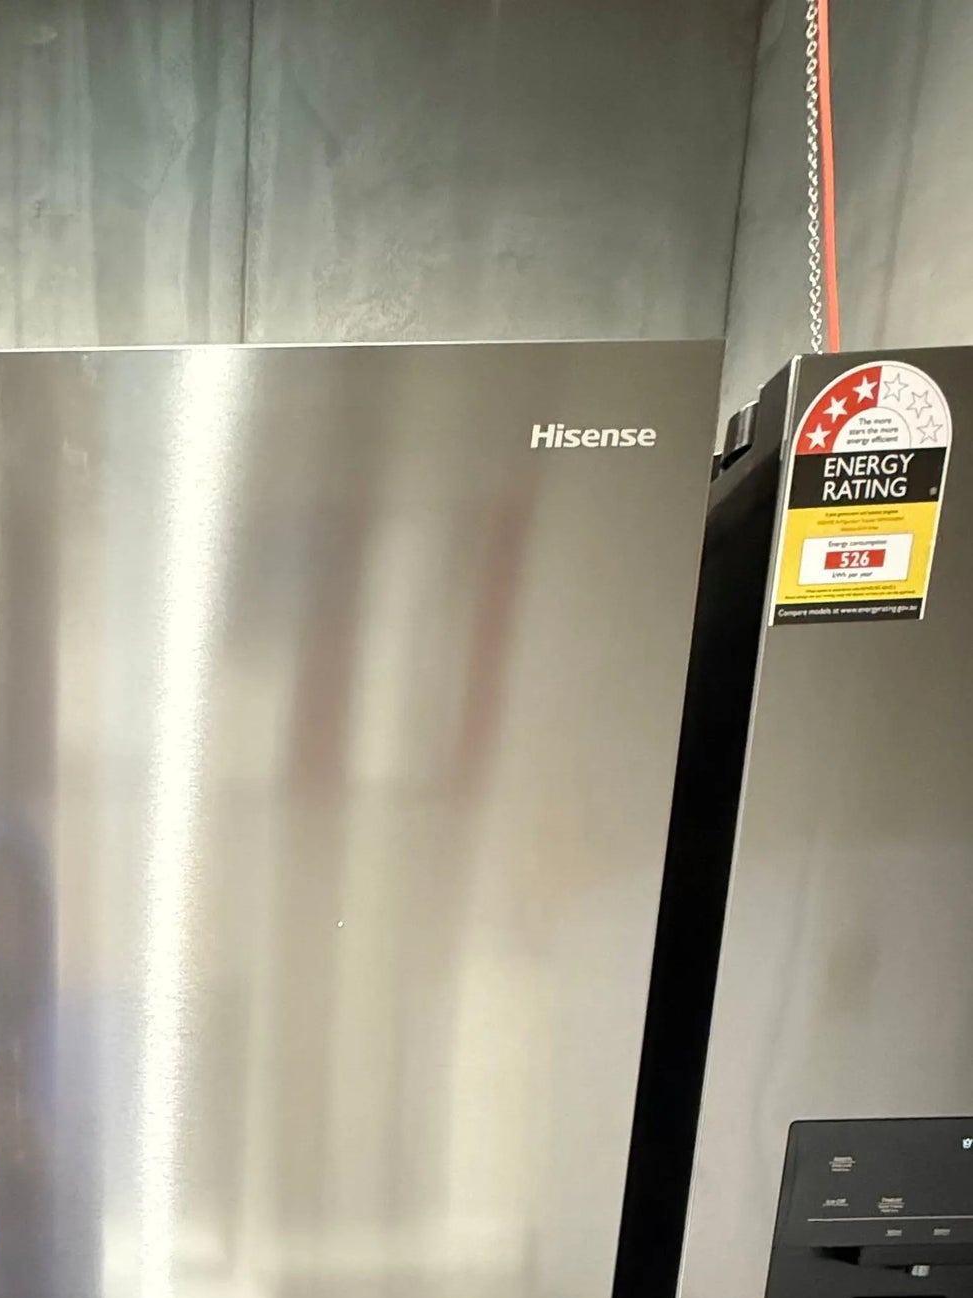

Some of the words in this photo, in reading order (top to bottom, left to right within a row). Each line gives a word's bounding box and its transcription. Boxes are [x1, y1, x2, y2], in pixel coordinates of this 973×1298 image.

[530, 423, 657, 448] Hisense
[823, 453, 915, 478] ENERGY
[822, 477, 908, 501] RATING
[839, 551, 871, 568] 526
